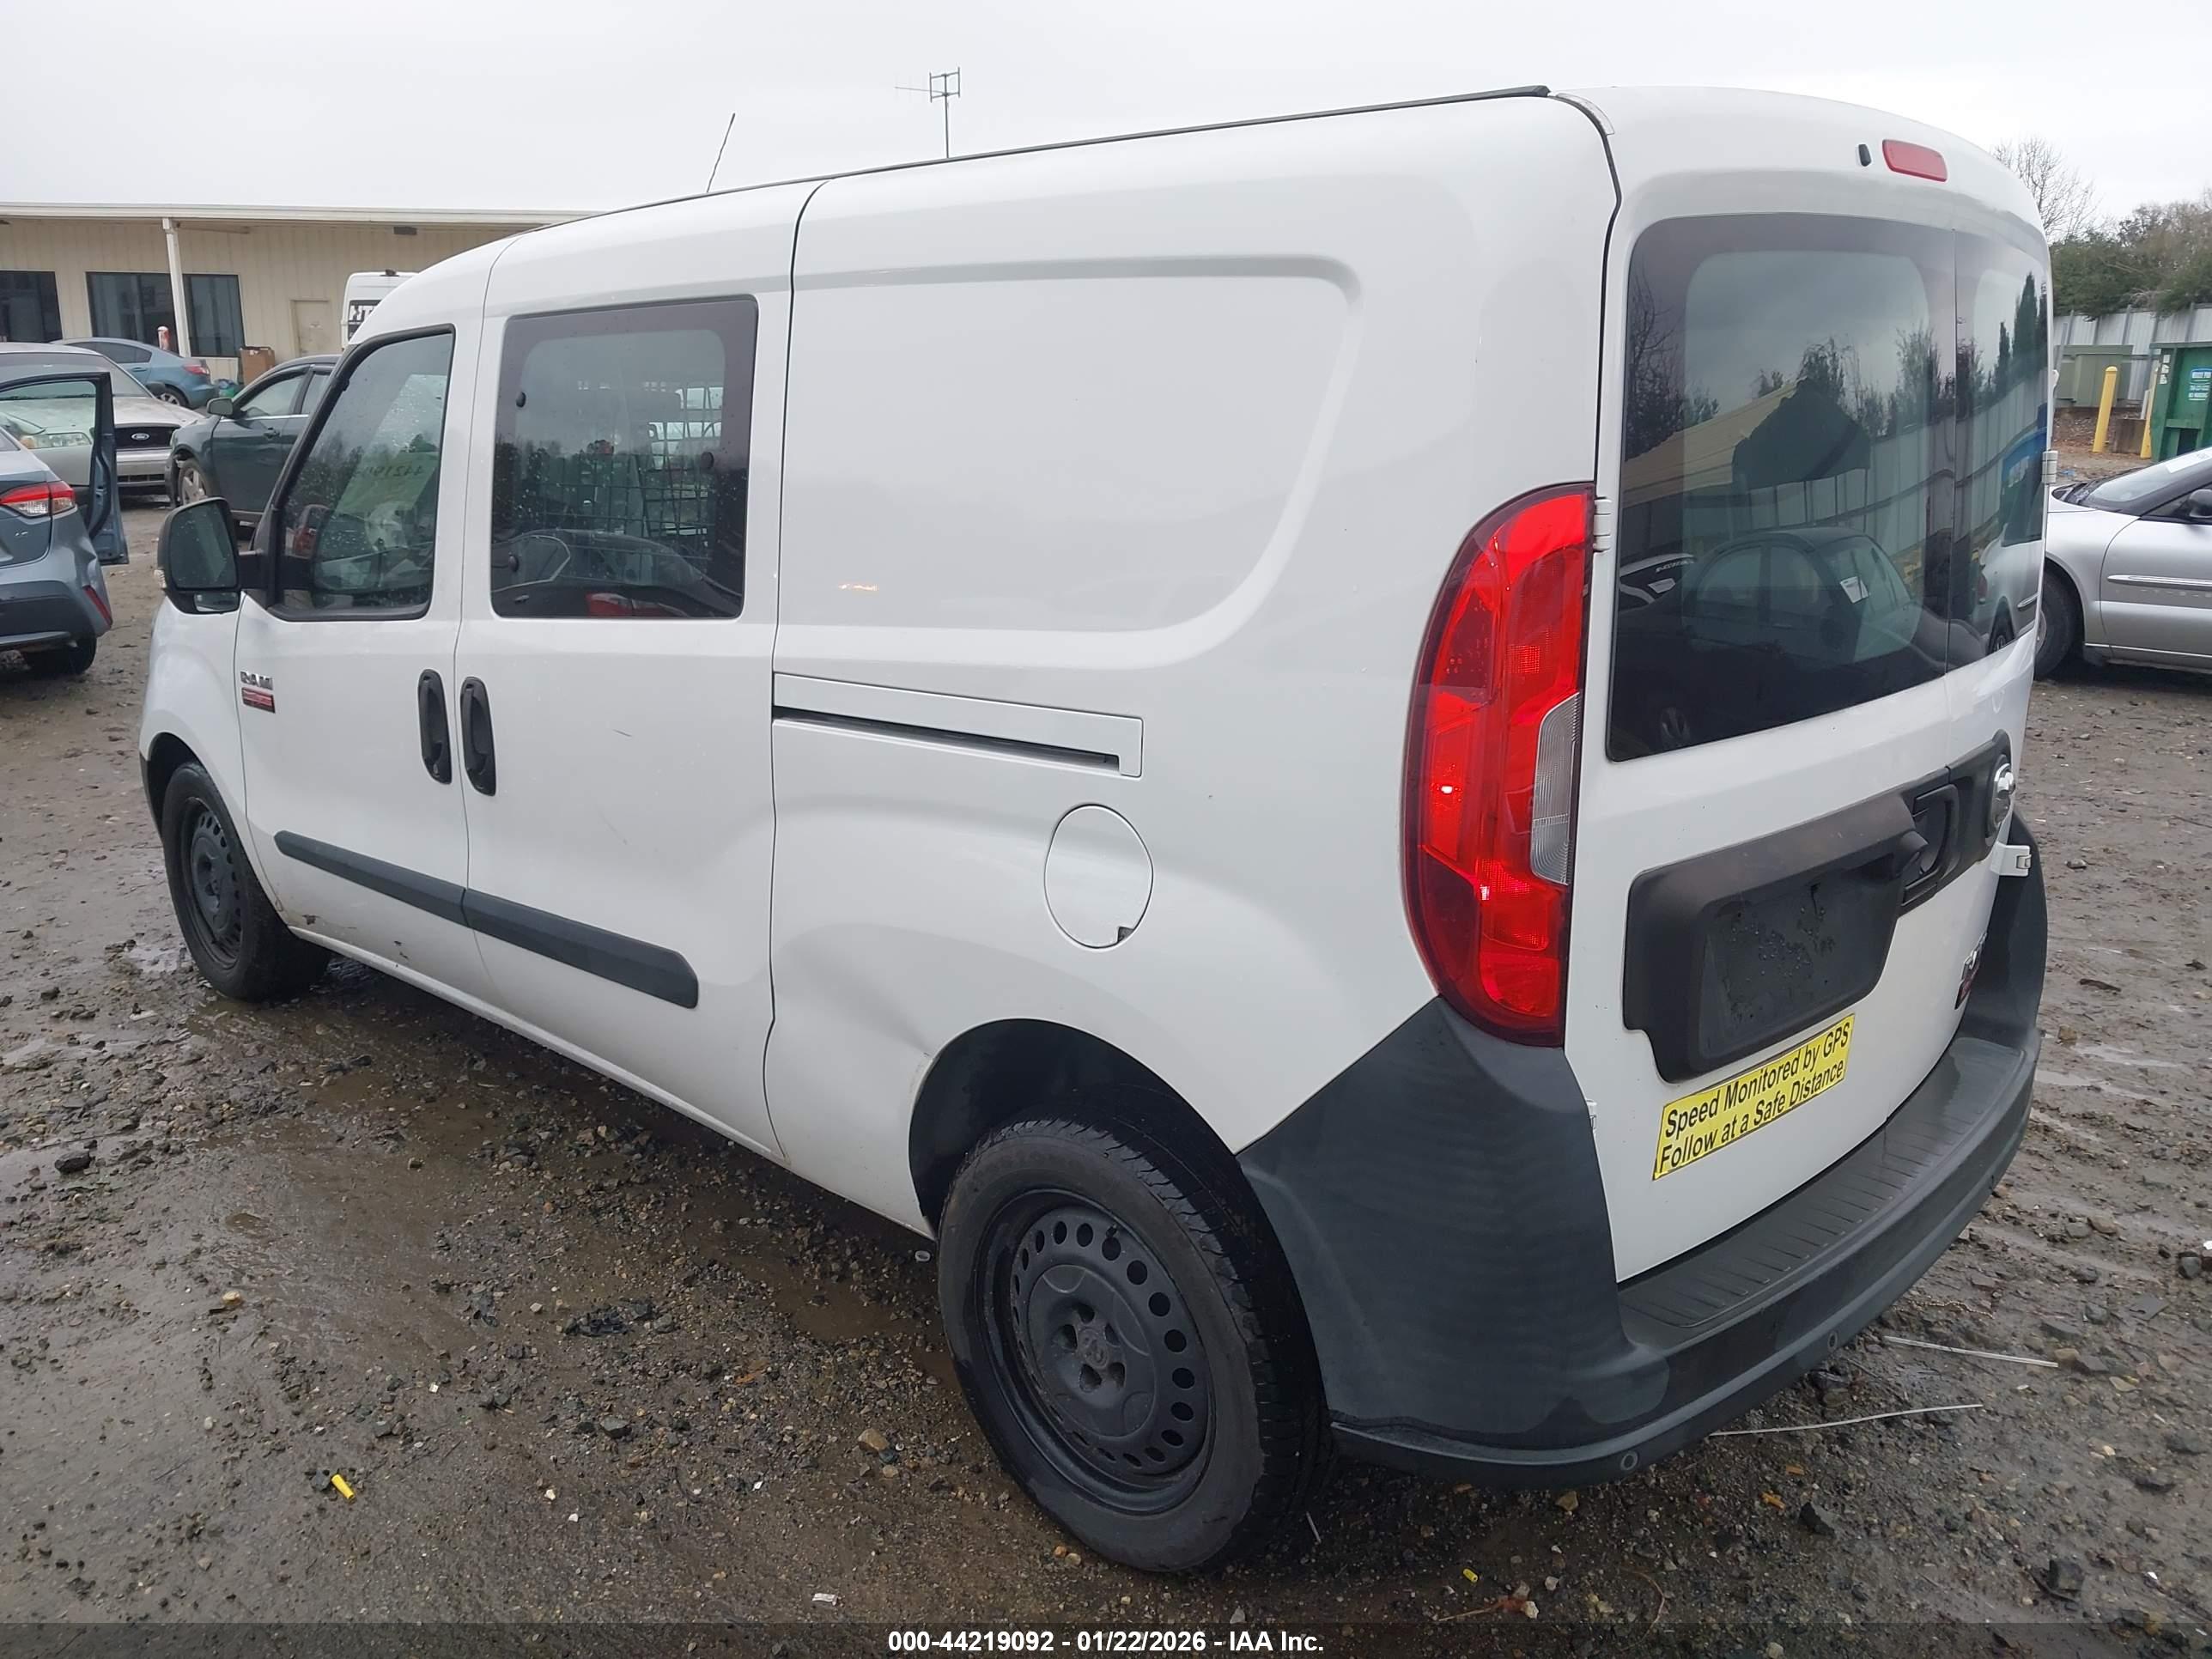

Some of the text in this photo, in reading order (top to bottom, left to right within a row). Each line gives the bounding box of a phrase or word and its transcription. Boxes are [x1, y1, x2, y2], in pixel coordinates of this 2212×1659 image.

[1659, 1060, 1844, 1174] Follow at a Safe Distance
[1665, 1022, 1850, 1139] Speed Monitored by GPS
